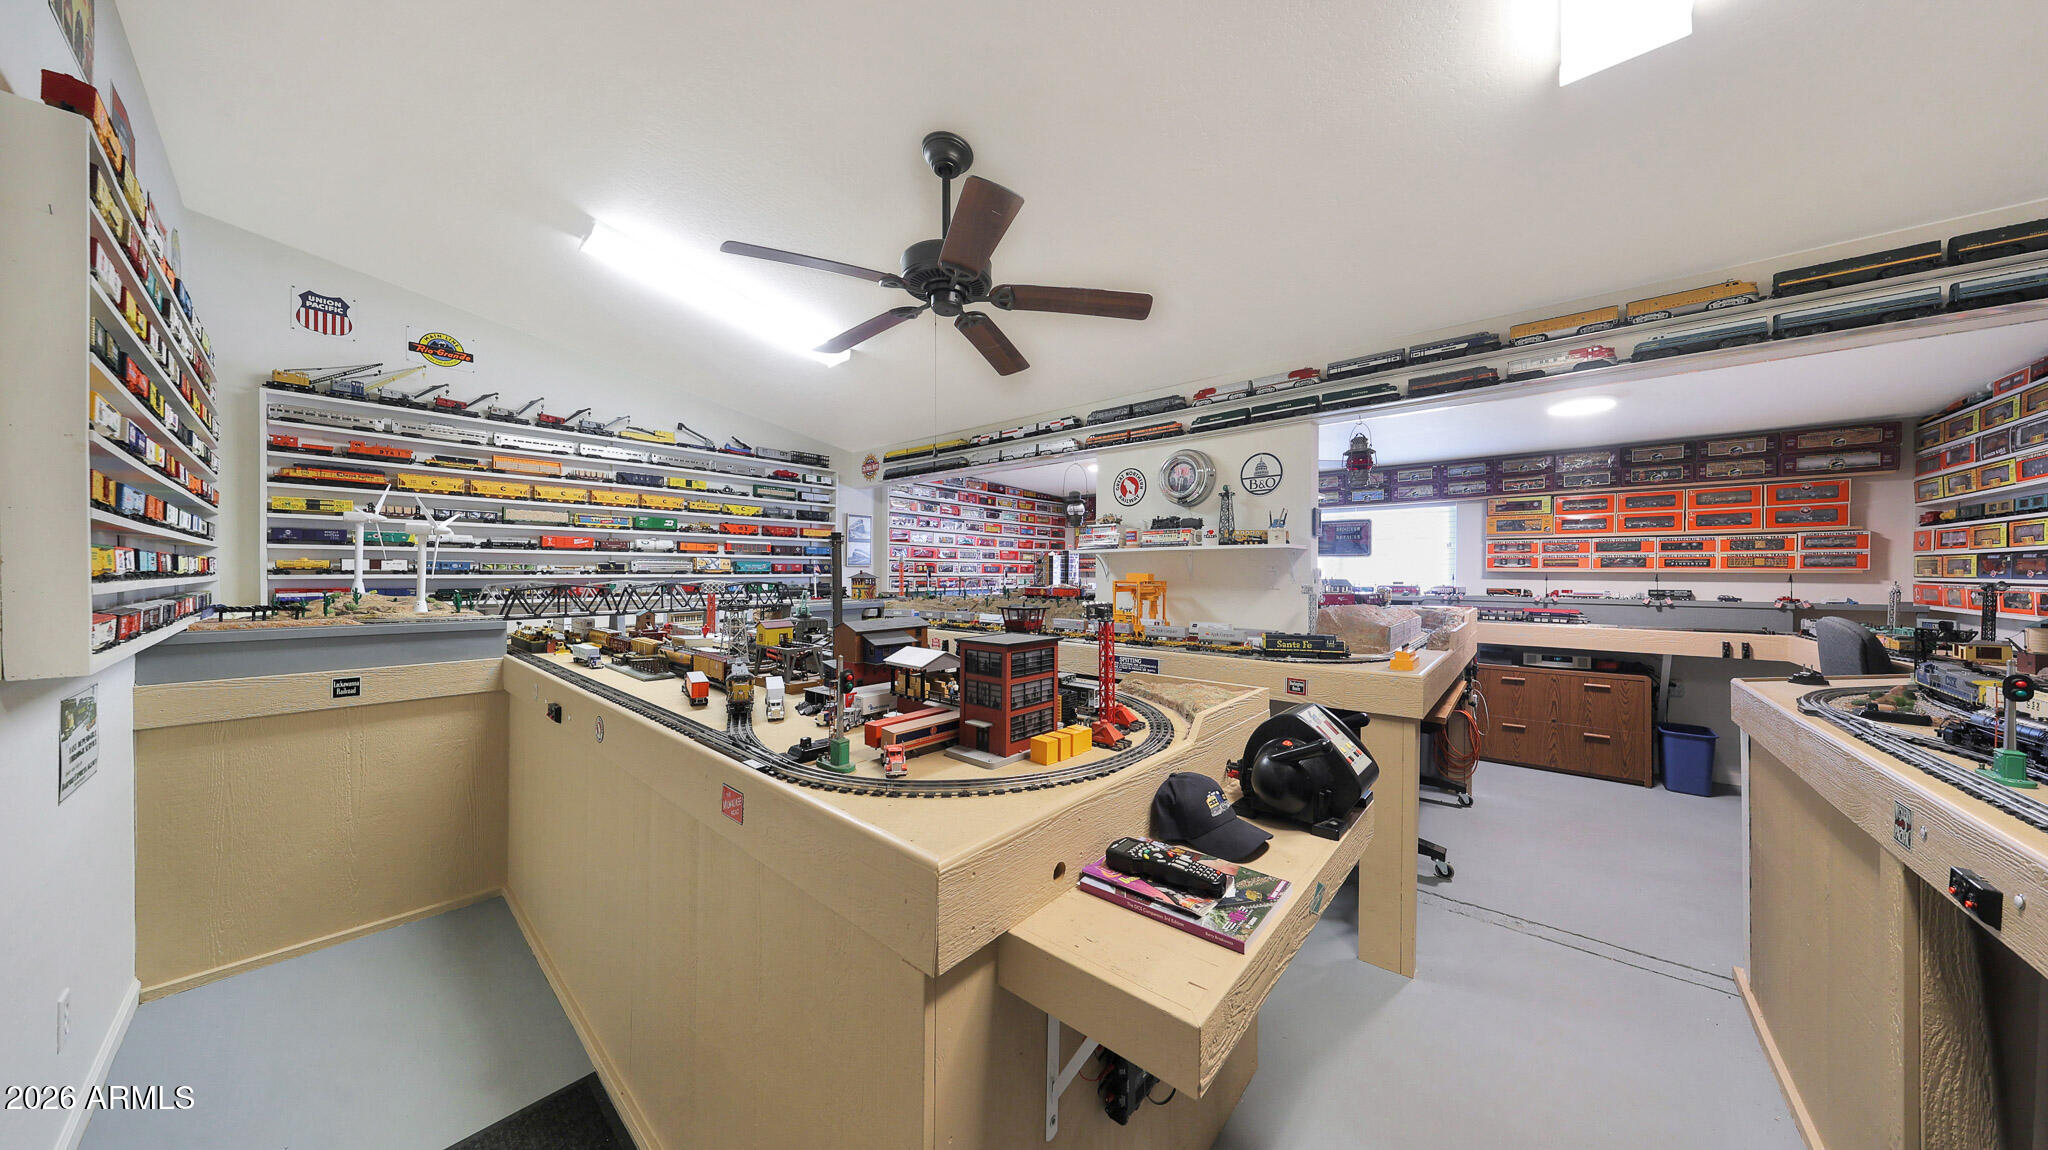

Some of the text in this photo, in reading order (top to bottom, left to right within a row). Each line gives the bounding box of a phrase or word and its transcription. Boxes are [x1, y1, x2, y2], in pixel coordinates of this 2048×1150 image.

[305, 300, 344, 314] PACIFIC
[308, 295, 342, 308] UNION
[412, 343, 434, 355] Rio
[434, 348, 472, 361] Grande
[1115, 471, 1144, 491] GREAT NORTHERN
[1249, 477, 1276, 490] B&O
[1118, 494, 1140, 504] RAILWAY
[1276, 640, 1313, 649] Santa Fe
[1119, 656, 1142, 664] SPITTING
[333, 681, 360, 689] Lackawanna
[1945, 675, 1958, 688] CSX
[336, 687, 357, 695] Railroad
